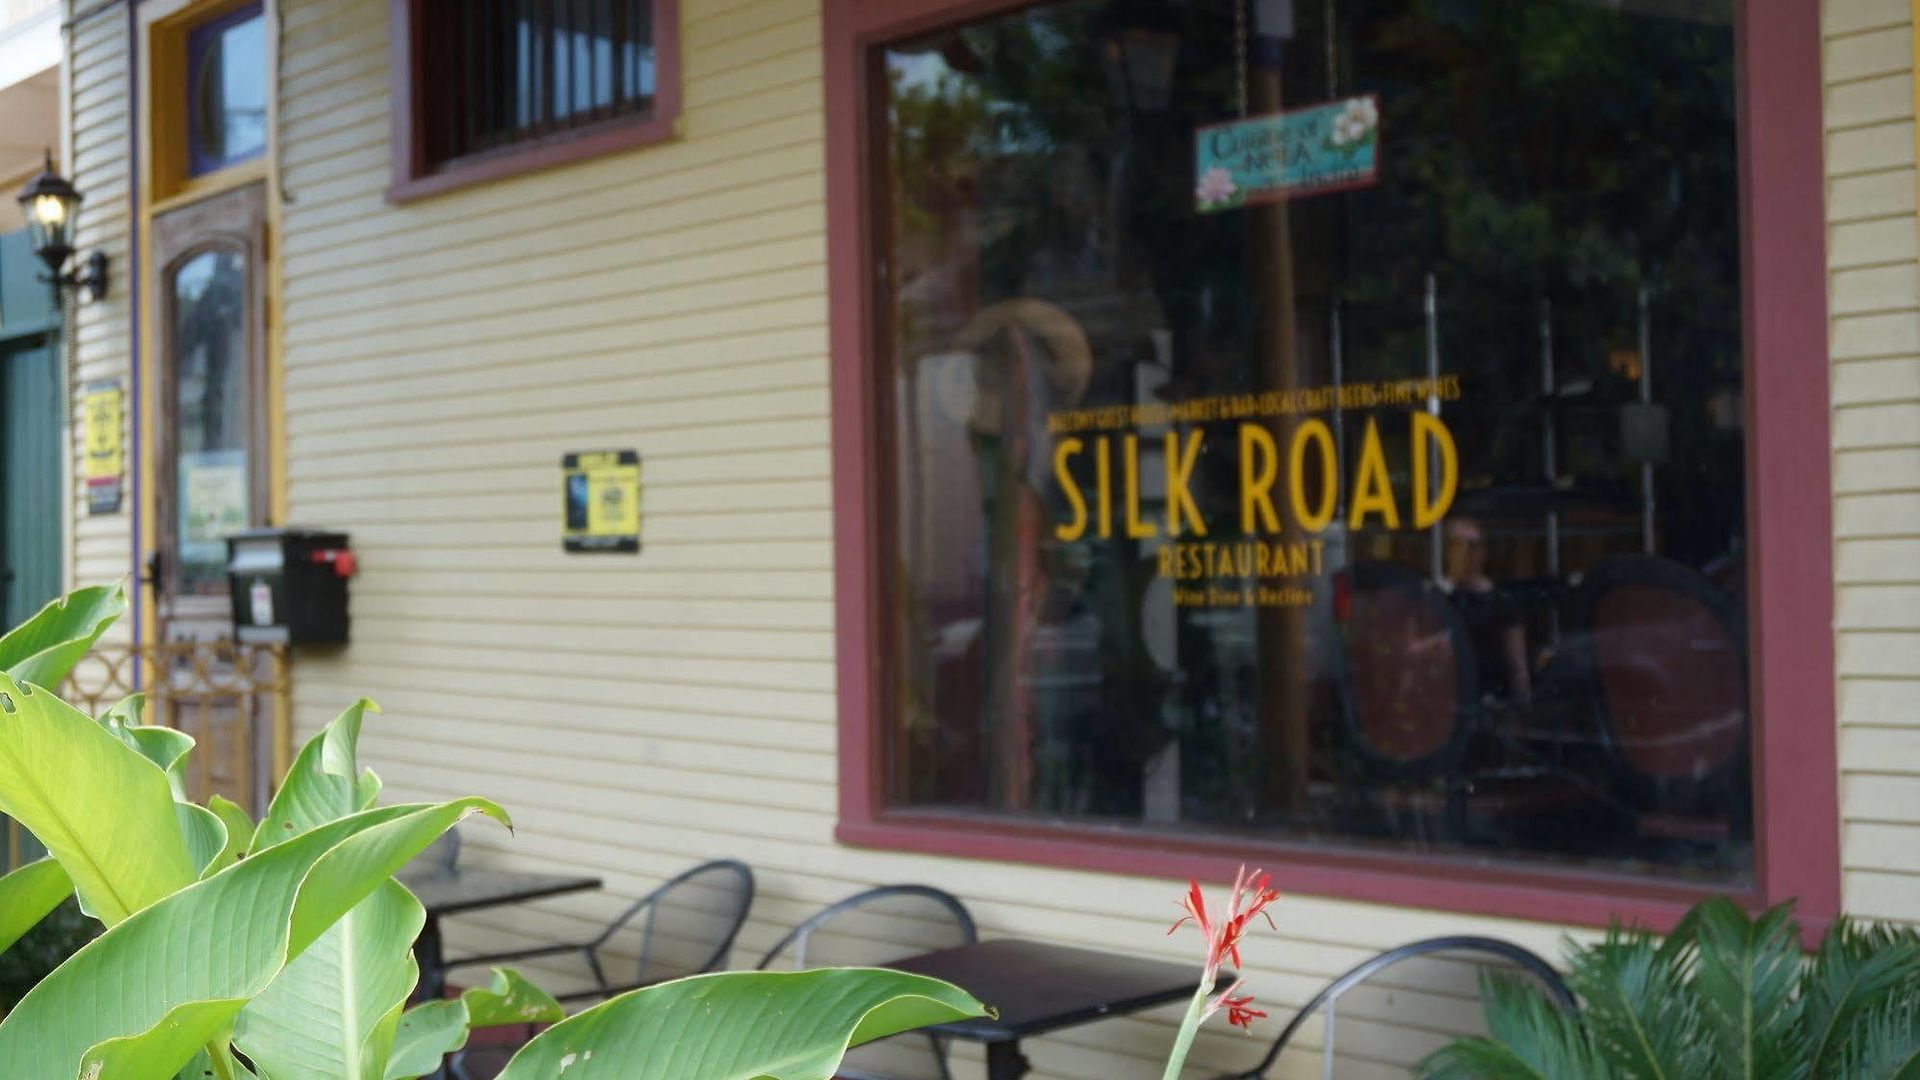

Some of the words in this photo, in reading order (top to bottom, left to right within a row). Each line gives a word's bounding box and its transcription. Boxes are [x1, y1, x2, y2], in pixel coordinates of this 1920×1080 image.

[1053, 428, 1208, 542] SILK
[1238, 411, 1459, 534] ROAD
[1158, 540, 1324, 579] RESTAURANT
